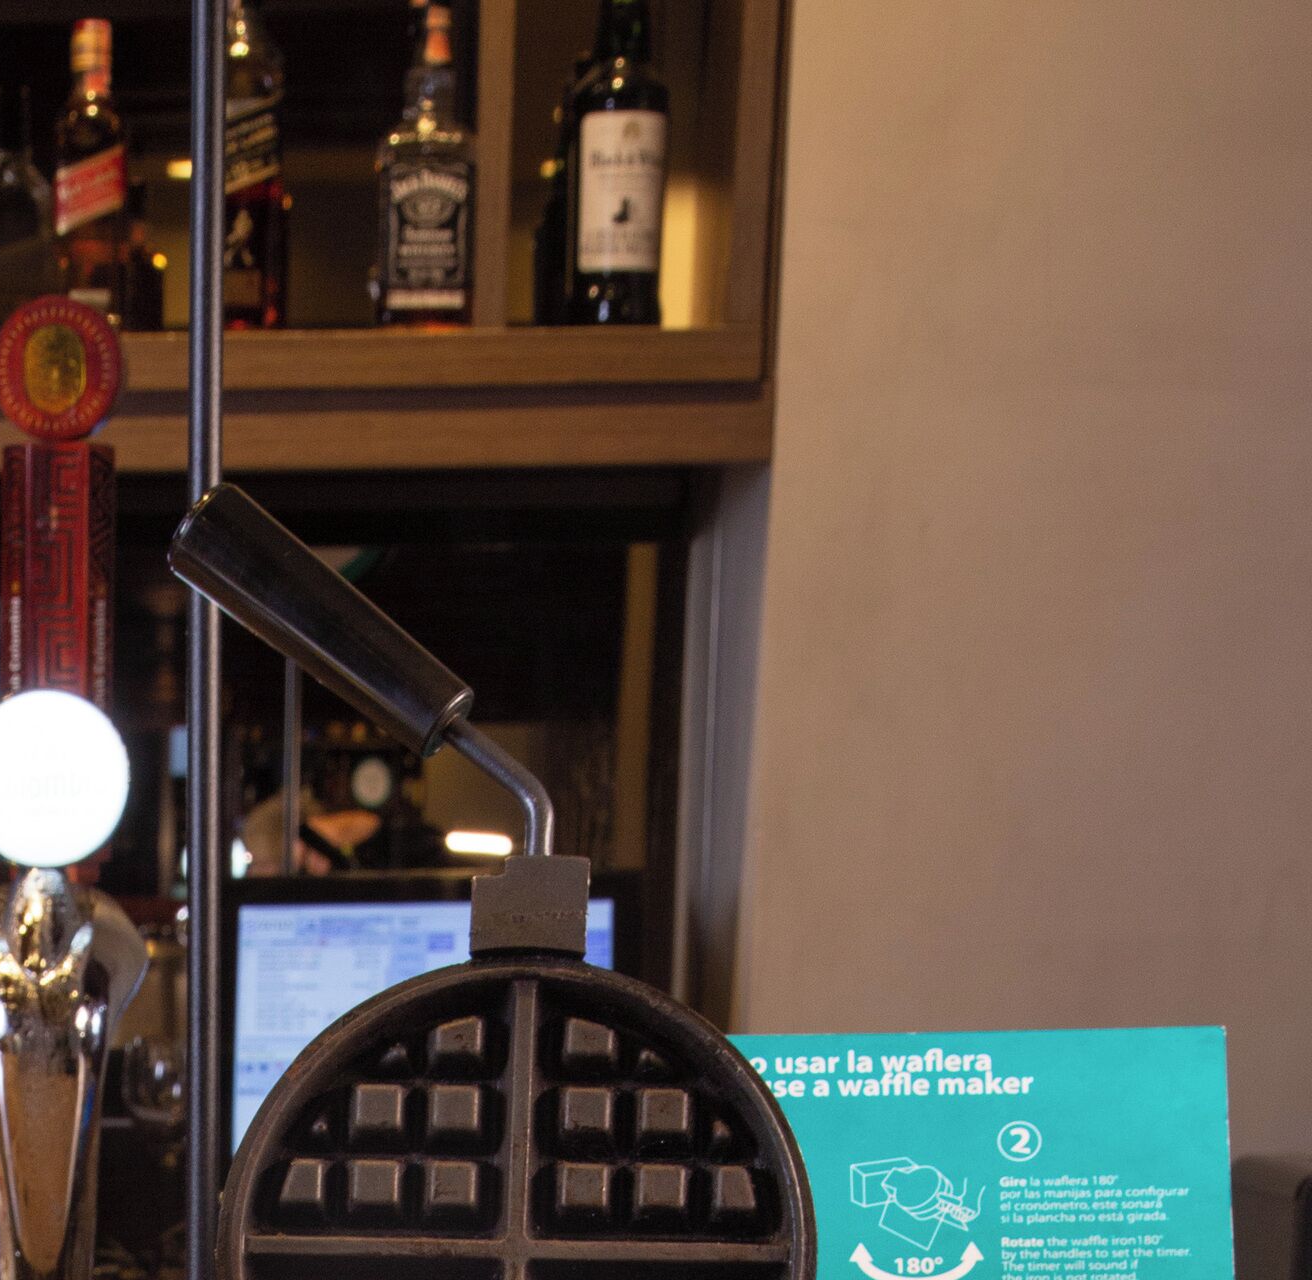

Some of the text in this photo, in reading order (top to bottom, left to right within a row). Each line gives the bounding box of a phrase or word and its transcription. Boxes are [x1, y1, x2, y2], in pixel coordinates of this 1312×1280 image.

[775, 1056, 839, 1074] usar
[847, 1050, 873, 1073] la
[881, 1048, 992, 1073] waflera
[813, 1080, 830, 1097] a
[838, 1072, 930, 1097] waffle
[938, 1072, 1034, 1095] maker
[1010, 1127, 1031, 1154] 2
[999, 1176, 1027, 1187] Gire
[1030, 1176, 1040, 1187] la
[1043, 1175, 1088, 1187] waflera
[1000, 1185, 1189, 1201] por las manijas para configurar
[1000, 1201, 1011, 1211] el
[1092, 1201, 1117, 1210] este
[1121, 1199, 1163, 1209] sonará
[1001, 1211, 1169, 1225] si la plancha no está girada.
[1001, 1236, 1044, 1248] Rotate
[1047, 1236, 1067, 1247] the
[1071, 1235, 1108, 1246] waffle
[1001, 1247, 1192, 1262] by the handles to set the timer.
[894, 1256, 944, 1275] 180°
[1002, 1259, 1139, 1272] The timer will sound if
